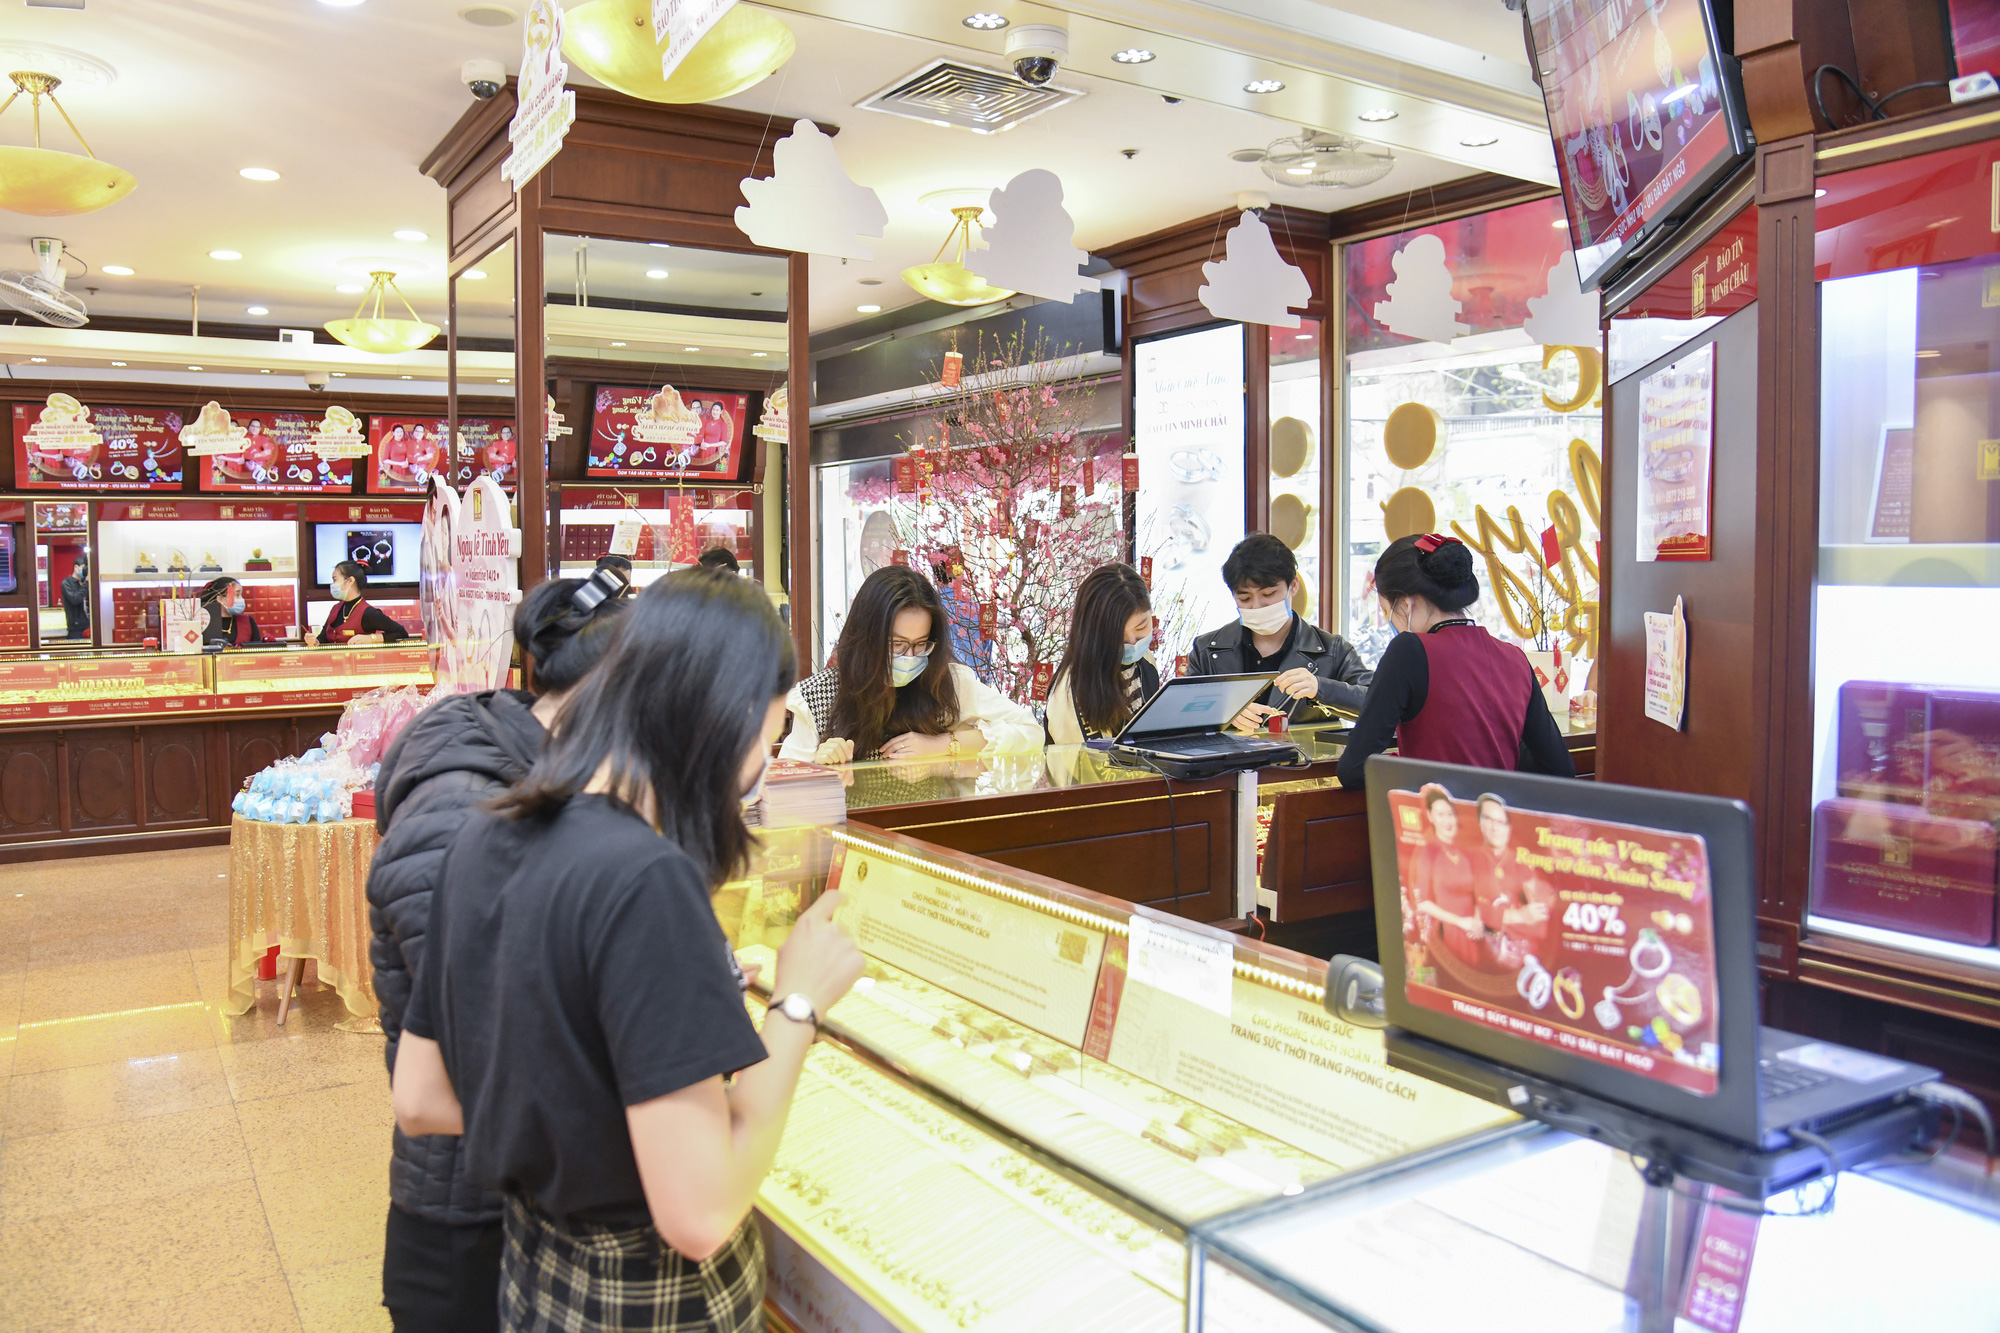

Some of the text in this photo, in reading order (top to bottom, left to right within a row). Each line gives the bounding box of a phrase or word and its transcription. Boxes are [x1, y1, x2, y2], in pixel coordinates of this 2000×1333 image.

[548, 68, 562, 93] VÀNG
[547, 94, 570, 140] TRIỆU
[1673, 158, 1686, 189] NGỜ
[1716, 235, 1744, 272] BẢO TÍN
[1711, 262, 1750, 304] MINH CHÂU
[94, 414, 116, 423] Trang
[133, 414, 156, 424] Vàng
[126, 424, 164, 434] Xuân Sang
[274, 419, 296, 428] Trang
[1180, 419, 1203, 430] MINH
[109, 438, 138, 450] 40%
[350, 445, 372, 454] TRIỆU
[457, 529, 510, 562] Ngày lễ Tình Yêu
[468, 568, 497, 582] Valentine 14/2
[1535, 826, 1669, 871] Trang sức Vàng
[1516, 846, 1696, 900] Rạng rỡ đón Xuân Sang
[912, 891, 922, 902] CHO
[922, 894, 940, 908] PHONG
[935, 886, 951, 898] TRANG
[900, 900, 916, 912] TRANG
[926, 906, 939, 919] THỜI
[938, 912, 956, 927] TRANG
[956, 918, 974, 934] PHONG
[975, 925, 990, 940] CÁCH
[1562, 902, 1627, 936] 40%
[1251, 1013, 1371, 1065] CHO PHONG CÁCH HOÀN
[1296, 1010, 1355, 1039] TRANG SỨC
[1452, 1000, 1486, 1022] TRANG
[1486, 1008, 1508, 1027] SỨC
[1509, 1014, 1533, 1033] NHƯ
[1559, 1030, 1578, 1048] ƯU
[1624, 1049, 1654, 1072] NGỜ
[1230, 1024, 1417, 1102] TRANG SỨC THỜI TRANG PHONG CÁCH
